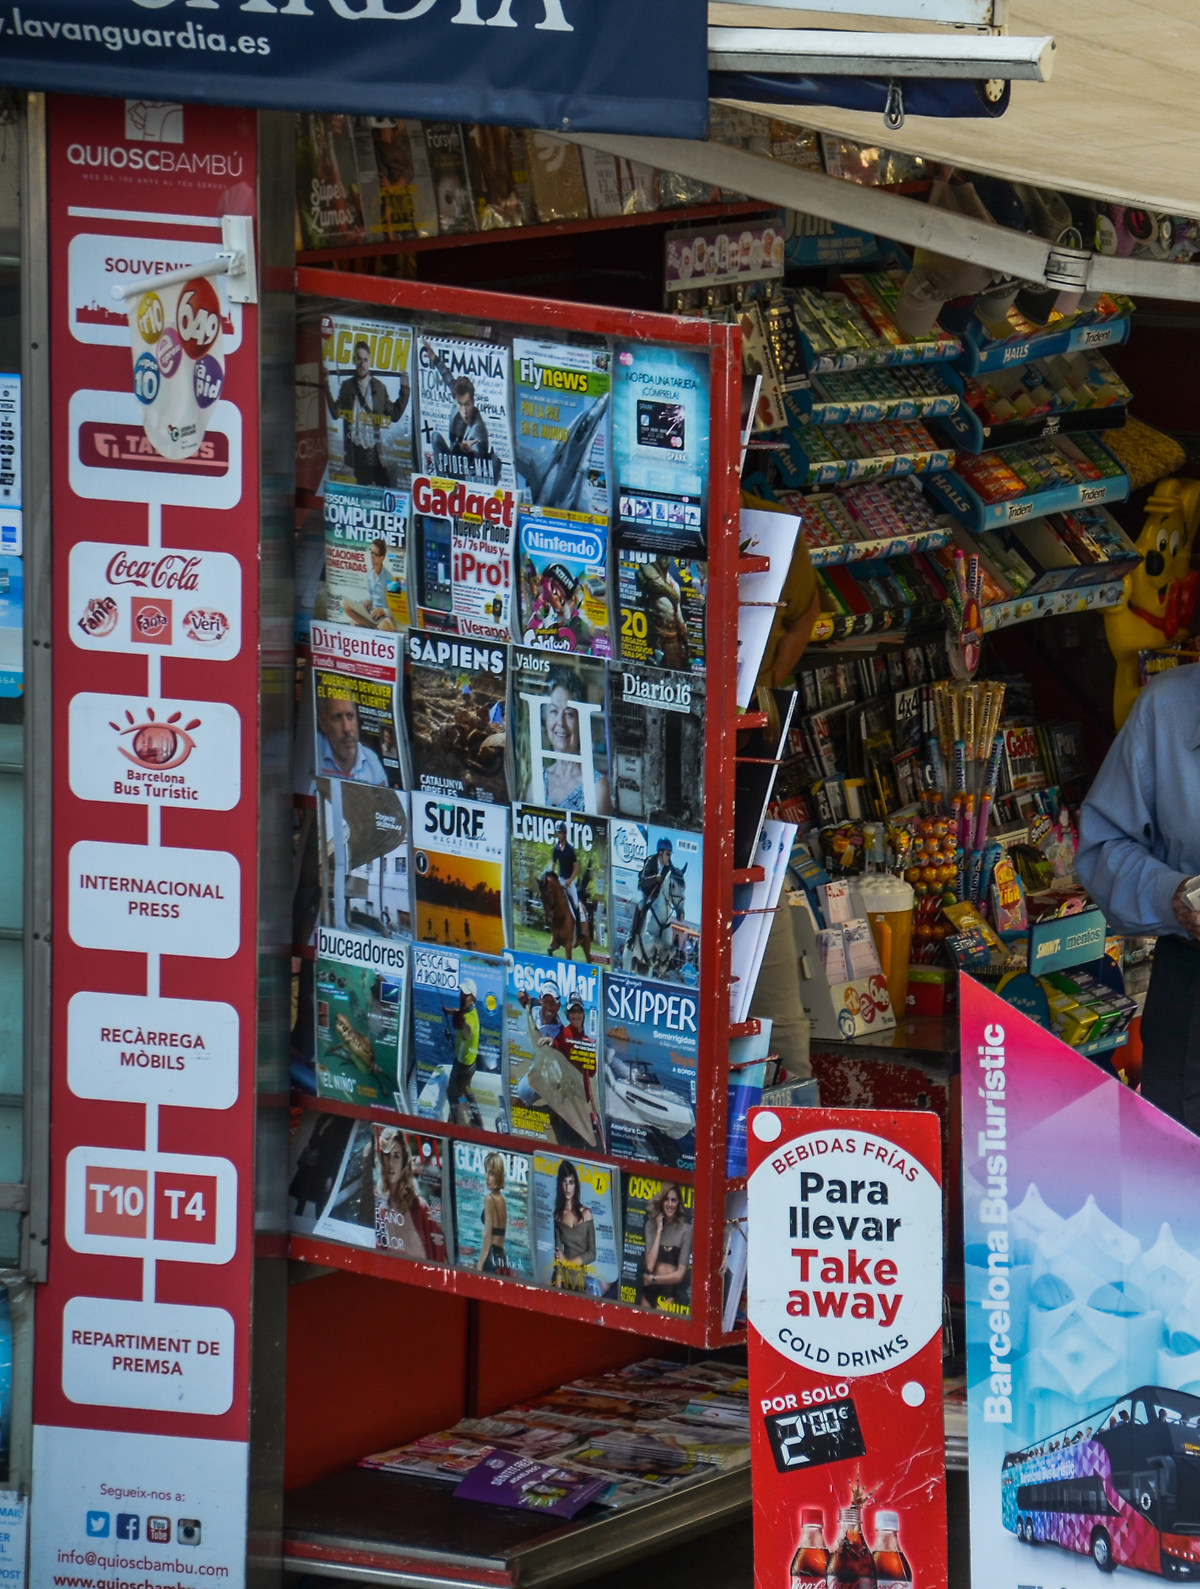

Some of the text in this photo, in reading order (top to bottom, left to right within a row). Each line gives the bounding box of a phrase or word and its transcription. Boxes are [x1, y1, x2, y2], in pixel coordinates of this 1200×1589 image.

[0, 8, 271, 55] .lavanguardia.es
[67, 144, 243, 177] QUIOSCBAMBÚ
[311, 178, 347, 207] Súper
[311, 206, 354, 233] Zumos
[177, 290, 219, 346] 649
[1003, 329, 1112, 364] HALLS Trident
[520, 358, 588, 392] Flynews
[413, 477, 515, 528] Gadget
[931, 473, 971, 513] HALLS
[1081, 487, 1107, 503] Trident
[1008, 503, 1034, 520] Trident
[528, 530, 595, 557] Nintendo
[106, 551, 202, 592] Coca-Cola
[136, 614, 168, 633] Fanta
[192, 617, 221, 632] Veri
[620, 608, 648, 639] 20
[312, 626, 395, 660] Dirigentes
[410, 636, 504, 674] SAPIENS
[114, 782, 199, 801] Bus Turístic
[127, 770, 185, 784] Barcelona
[424, 801, 486, 838] SURF
[433, 835, 480, 849] MAGAZINE
[80, 874, 224, 900] INTERNACIONAL
[128, 902, 180, 918] PRESS
[319, 928, 404, 969] buceadores
[1066, 928, 1102, 950] mentos
[416, 952, 443, 968] PESCA
[425, 970, 457, 990] BORDO
[607, 984, 697, 1033] SKIPPER
[100, 1027, 206, 1049] RECÀRREGA
[120, 1050, 185, 1070] MÒBILS
[771, 1138, 919, 1182] BEBIDAS FRÍAS
[90, 1184, 144, 1216] T10
[800, 1171, 889, 1205] Para
[164, 1190, 206, 1222] T4
[789, 1206, 902, 1241] llevar
[791, 1248, 898, 1286] Take
[786, 1288, 903, 1328] away
[72, 1330, 220, 1356] REPARTIMENT DE
[984, 1231, 1013, 1424] Barcelona
[778, 1328, 909, 1367] COLD DRINKS
[112, 1356, 183, 1376] PREMSA
[761, 1383, 849, 1415] POR SOLO
[100, 1483, 186, 1502] Segueix-nos a:
[57, 1549, 229, 1577] info@quioscbambu.com
